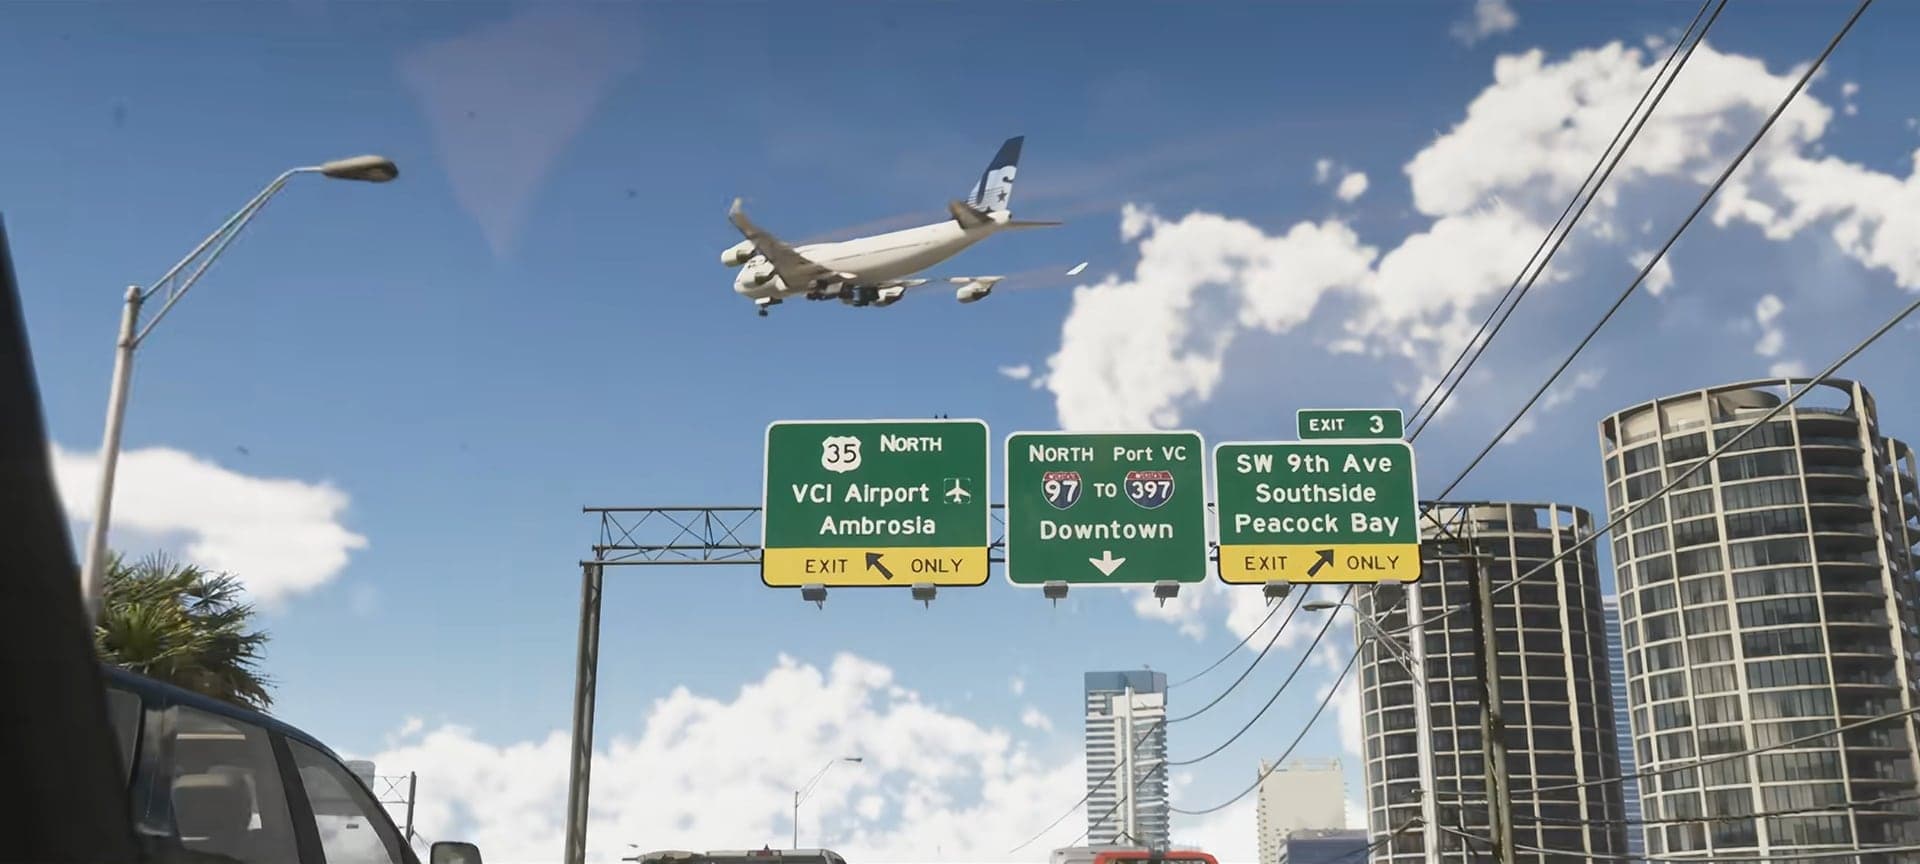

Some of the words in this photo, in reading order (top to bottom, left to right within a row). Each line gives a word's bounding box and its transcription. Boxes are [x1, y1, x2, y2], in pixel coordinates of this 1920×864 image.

[1309, 418, 1345, 431] EXIT
[1369, 415, 1384, 433] 3
[880, 434, 942, 452] NORTH
[827, 444, 857, 463] 35
[1029, 444, 1094, 462] NORTH
[1113, 446, 1153, 461] Port
[1162, 446, 1186, 461] VC
[1236, 454, 1273, 473] SW
[1287, 454, 1330, 473] 9th
[1342, 454, 1393, 473] Ave
[792, 483, 831, 503] VCI
[844, 483, 930, 507] Airport
[1044, 480, 1078, 502] 97
[1093, 483, 1117, 498] TO
[1131, 481, 1170, 499] 397
[1256, 483, 1377, 503] Southside
[820, 515, 936, 535] Ambrosia
[1040, 520, 1174, 540] Downtown
[1235, 513, 1339, 533] Peacock
[1351, 513, 1399, 537] Bay
[805, 559, 848, 573] EXIT
[911, 558, 963, 573] ONLY
[1245, 556, 1288, 570] EXIT
[1347, 555, 1399, 570] ONLY
